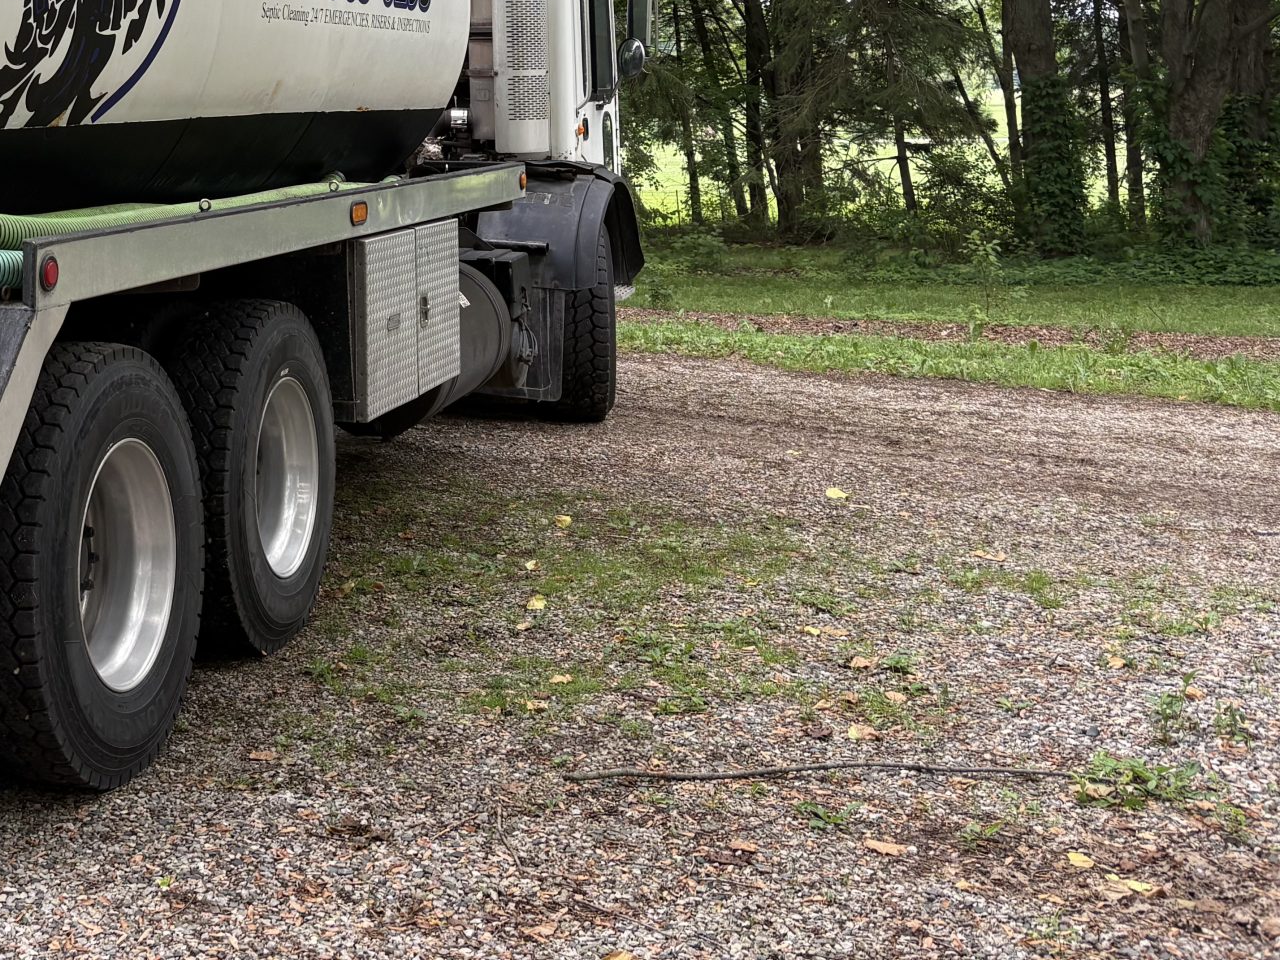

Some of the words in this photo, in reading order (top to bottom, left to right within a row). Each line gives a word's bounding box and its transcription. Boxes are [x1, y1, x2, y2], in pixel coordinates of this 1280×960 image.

[261, 1, 281, 23] Septic
[282, 3, 309, 26] Cleaning
[371, 14, 391, 30] RISERS
